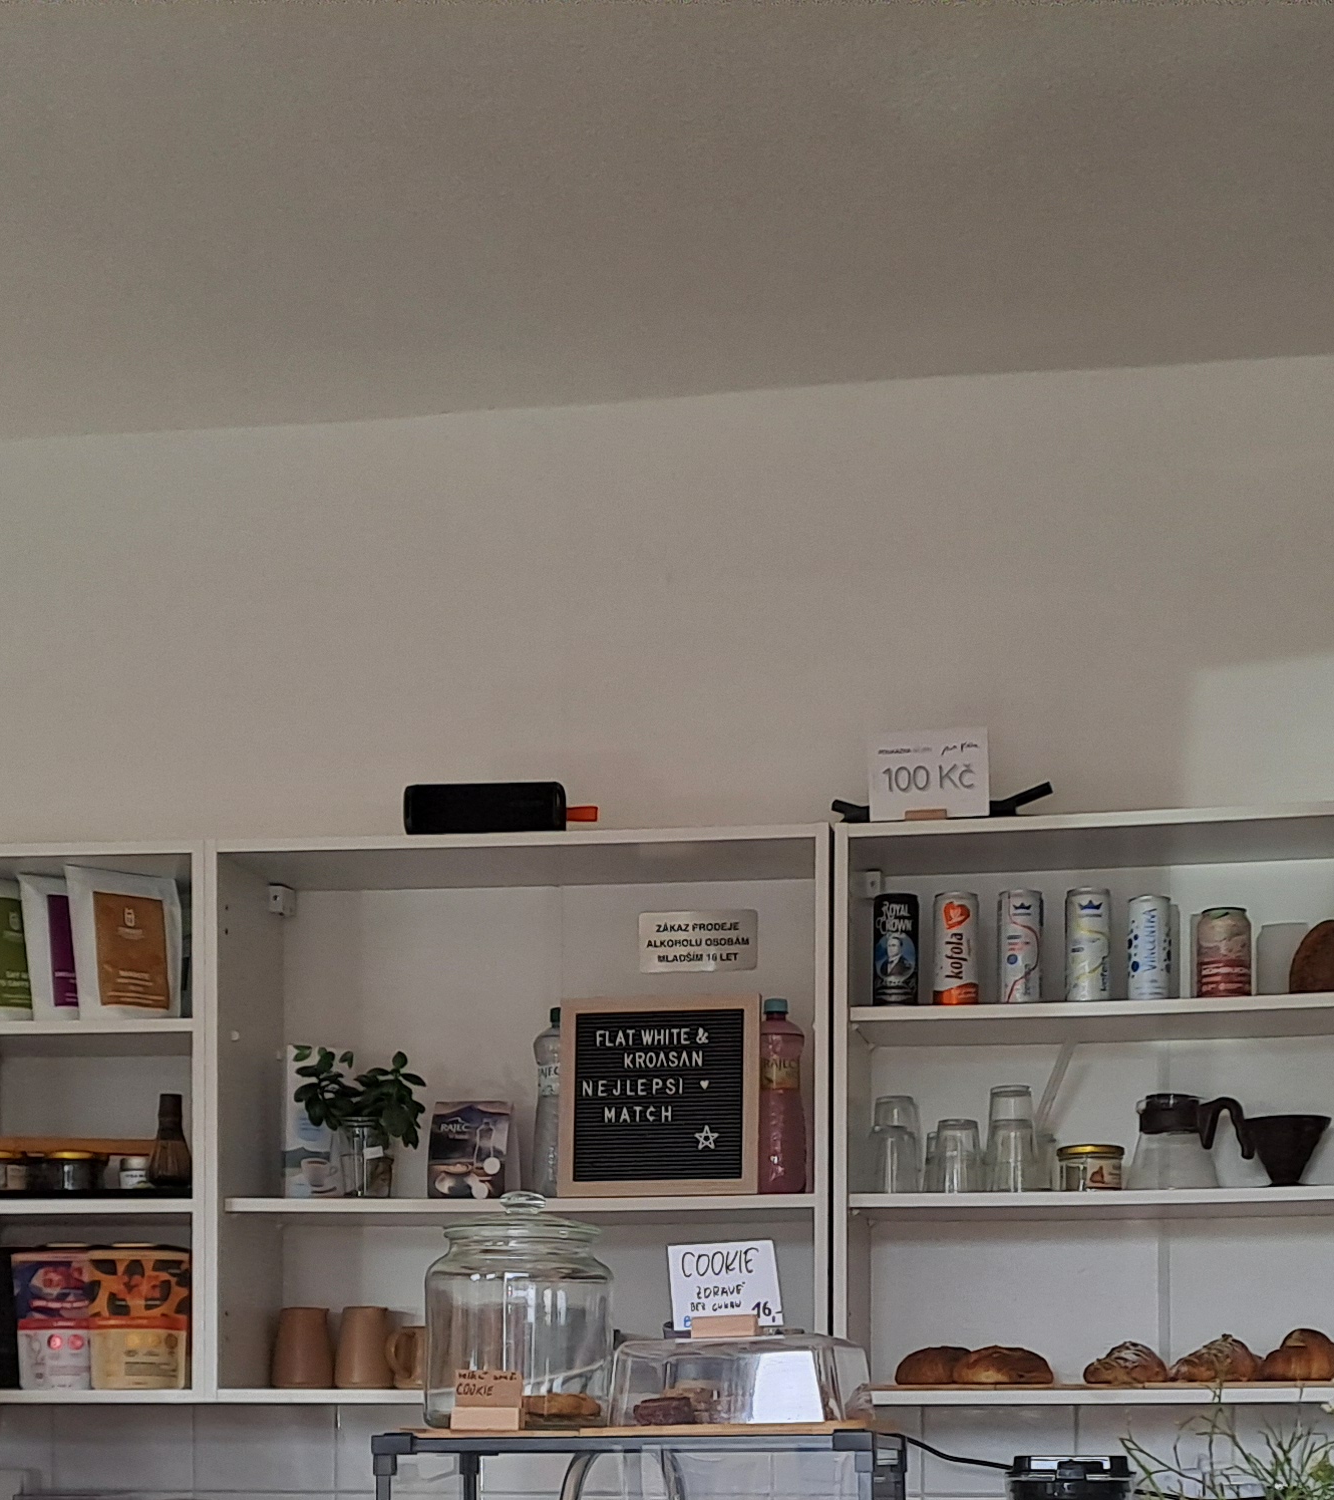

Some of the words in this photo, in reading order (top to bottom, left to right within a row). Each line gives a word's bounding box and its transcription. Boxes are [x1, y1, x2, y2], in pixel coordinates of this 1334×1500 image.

[882, 765, 930, 793] 100
[938, 763, 977, 790] Kč
[881, 901, 911, 921] ROYAL
[655, 922, 690, 933] ZÁKAZ
[691, 921, 740, 932] PRODEJE
[875, 916, 913, 936] CROWN
[646, 938, 702, 948] ALKOHOLU
[704, 935, 750, 947] OSOBÁM
[657, 951, 703, 963] MLADŠÍM
[719, 952, 739, 961] LET
[944, 932, 968, 980] kofola
[596, 1030, 635, 1047] FLAT
[641, 1028, 691, 1046] WHITE
[696, 1027, 709, 1044] &
[624, 1051, 703, 1069] KROASAN
[681, 1247, 759, 1278] COOKIE
[456, 1382, 494, 1396] COOKIE
